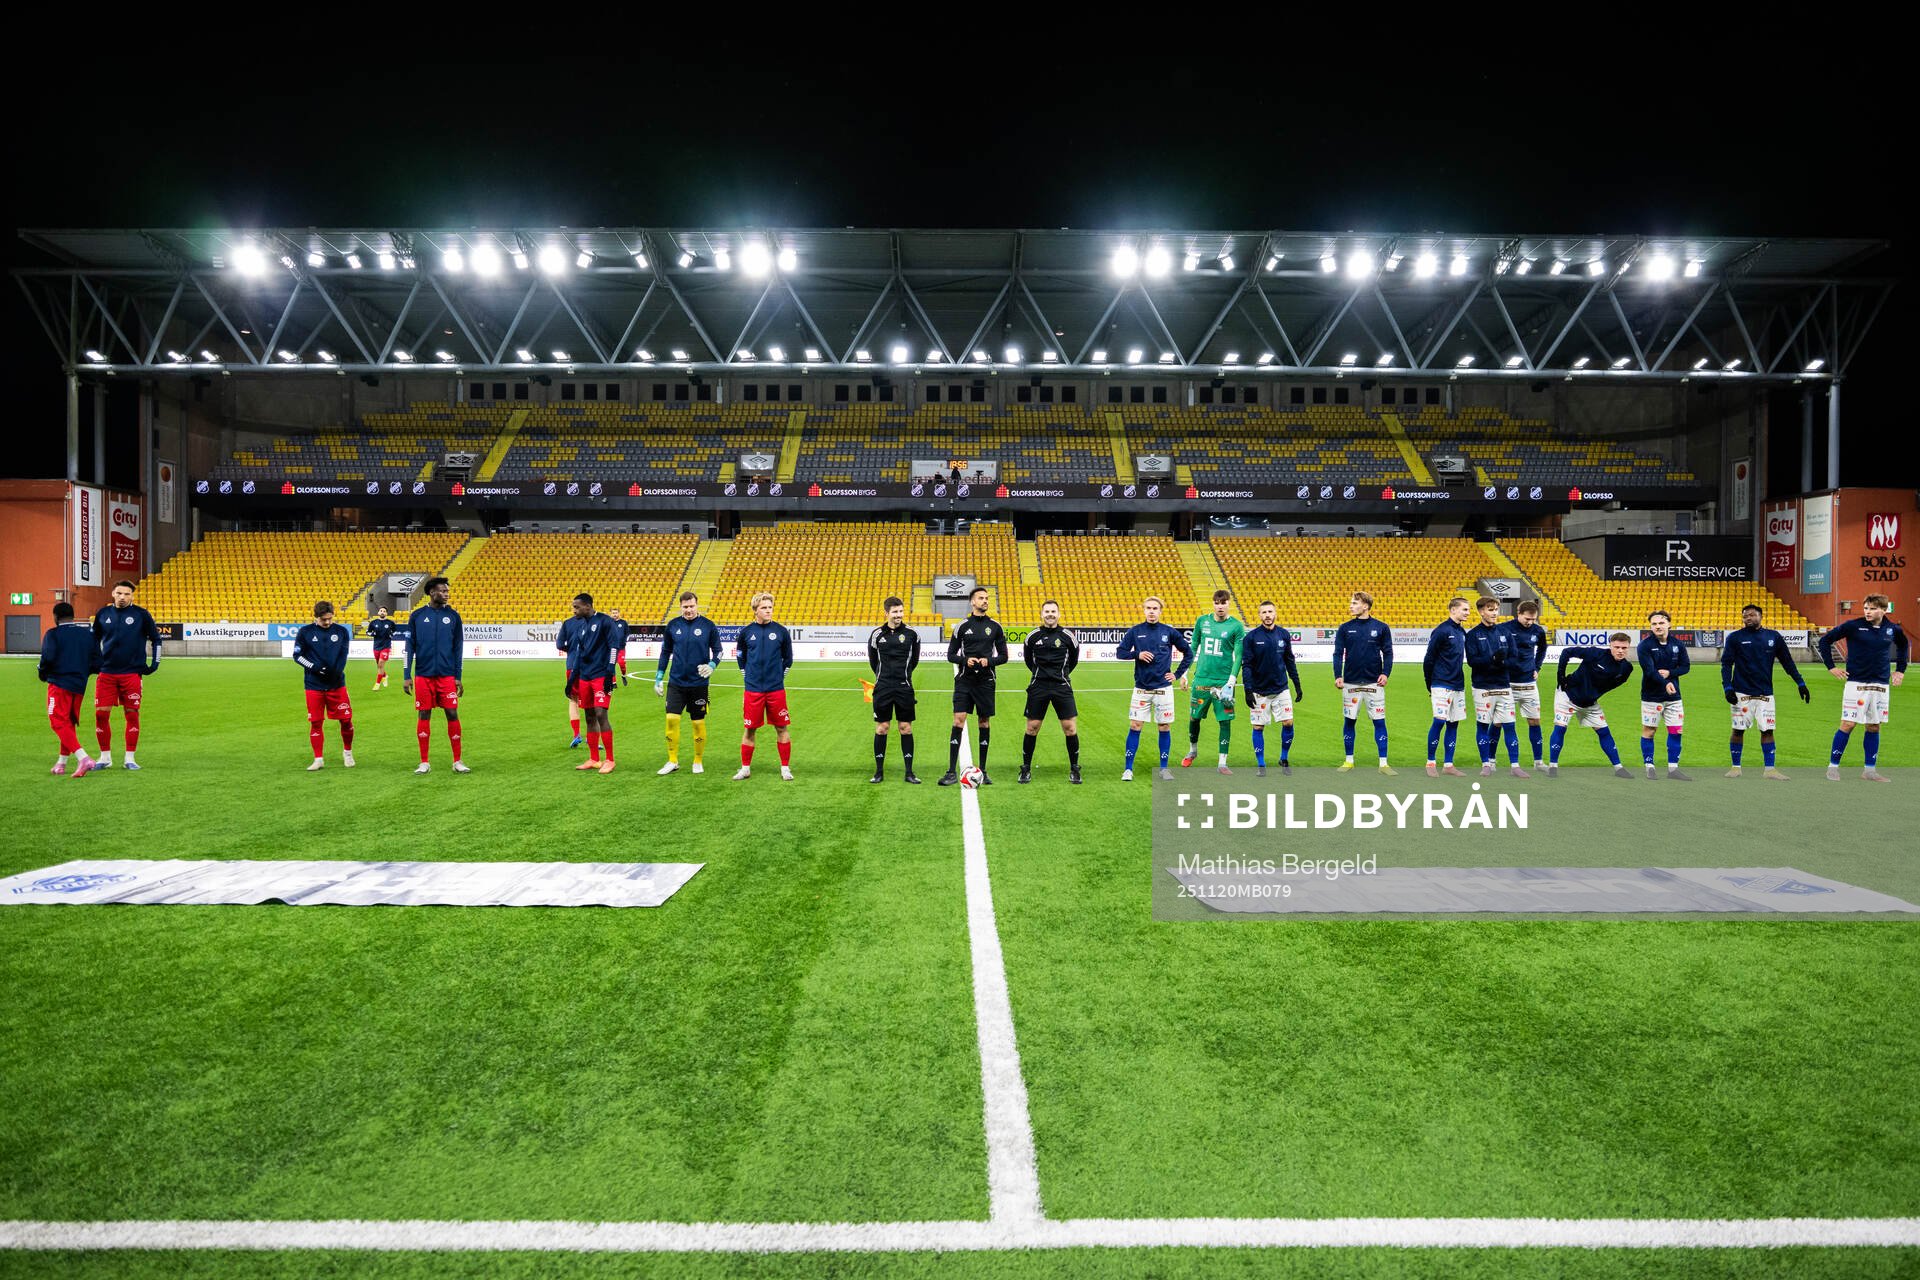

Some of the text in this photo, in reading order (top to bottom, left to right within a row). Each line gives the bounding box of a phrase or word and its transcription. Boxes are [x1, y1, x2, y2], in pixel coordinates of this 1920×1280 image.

[116, 548, 135, 560] 7-23
[1666, 540, 1693, 562] FR
[1771, 556, 1790, 567] 7-23
[1861, 553, 1906, 568] BORÅS
[1613, 565, 1746, 577] FASTIGHETSSERVICE
[1863, 570, 1899, 582] STAD
[193, 628, 265, 638] Akustikgruppen
[1204, 636, 1223, 657] EL
